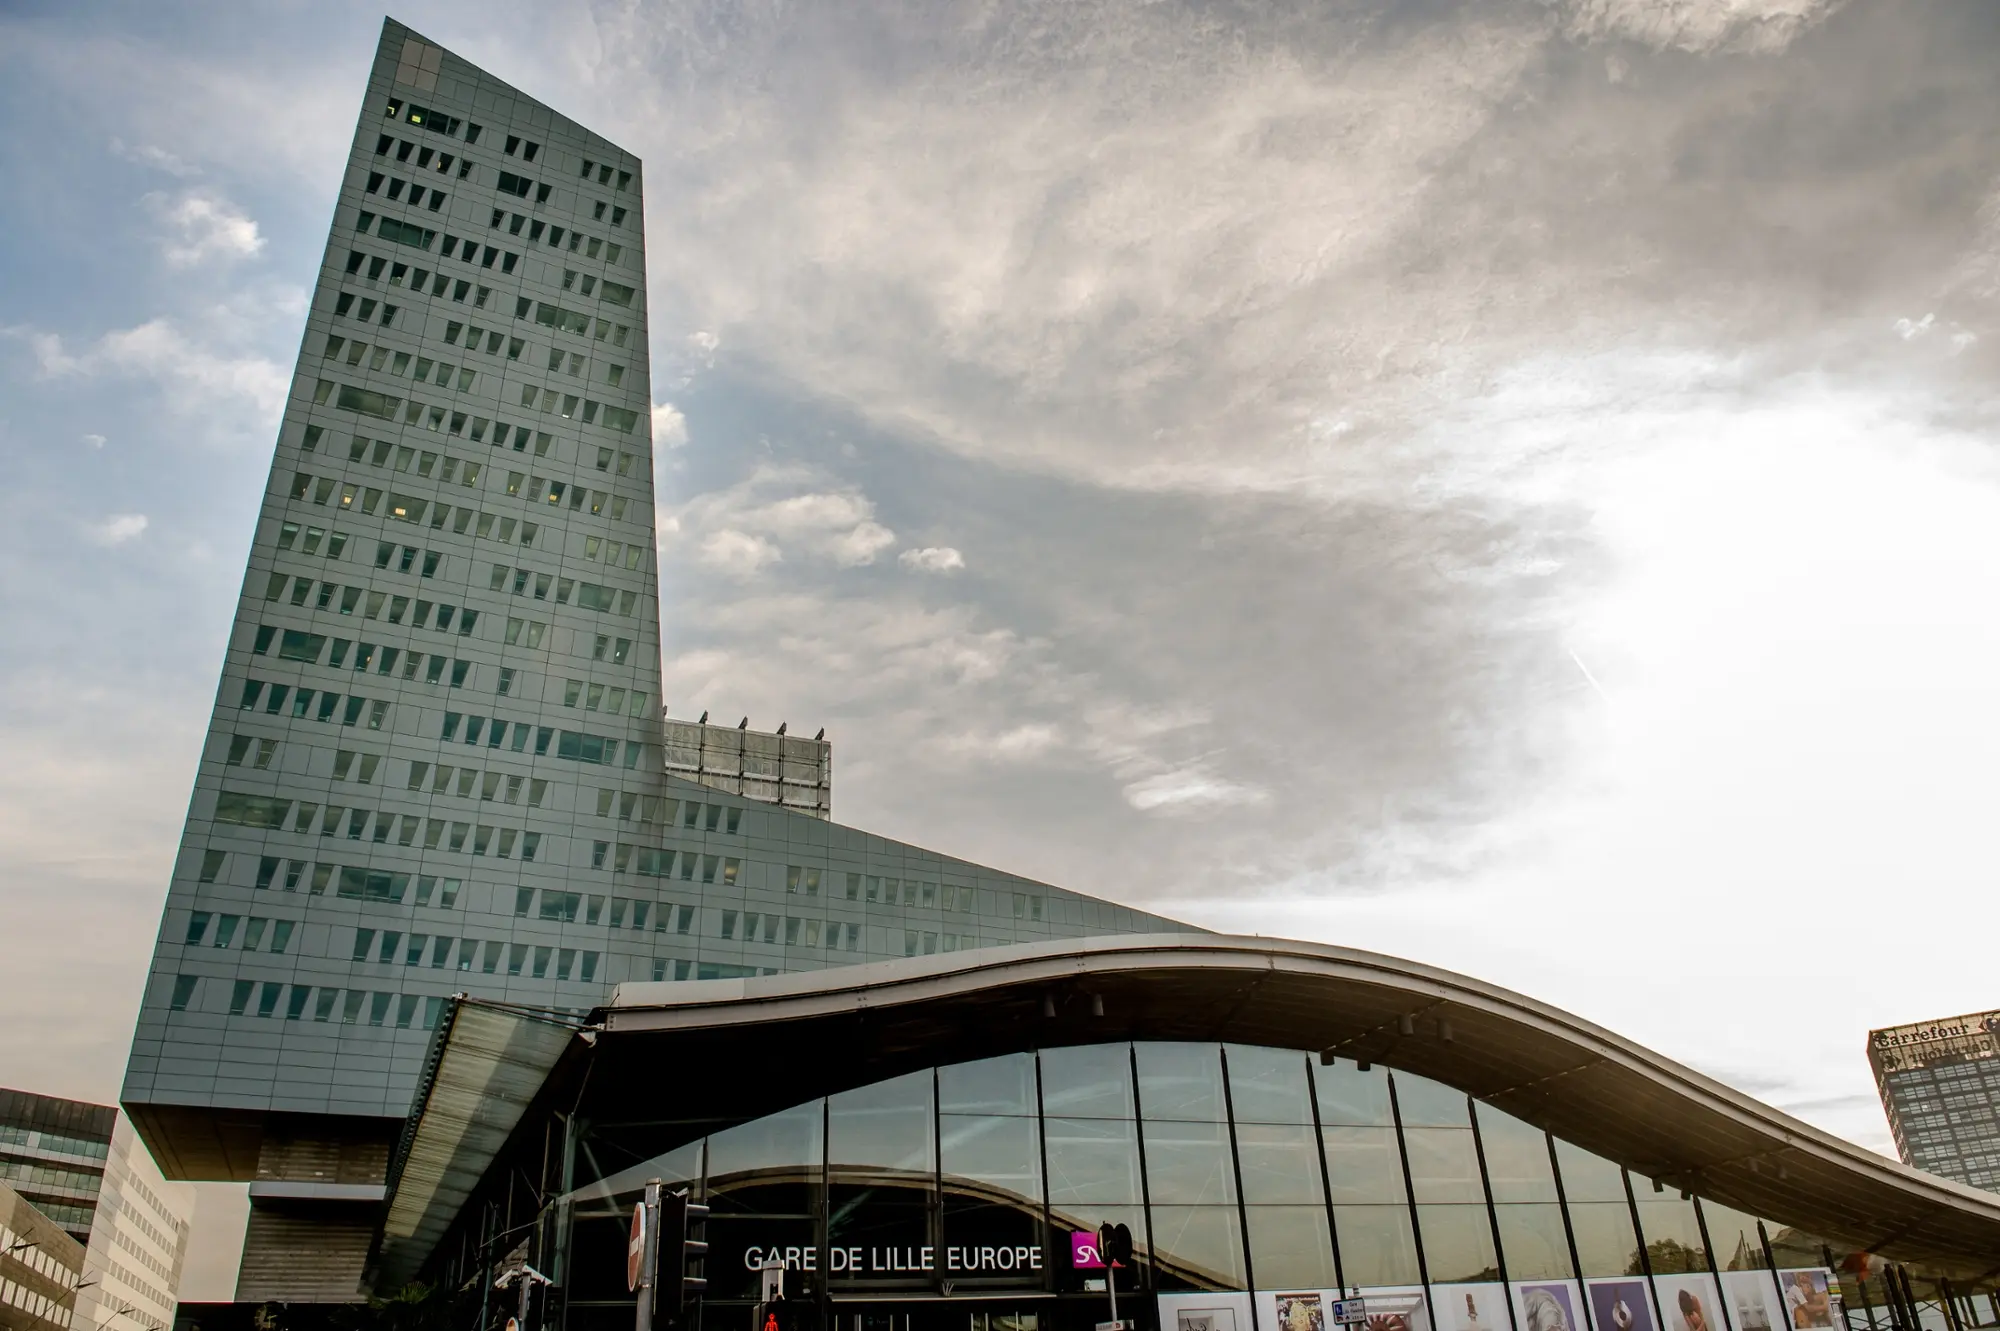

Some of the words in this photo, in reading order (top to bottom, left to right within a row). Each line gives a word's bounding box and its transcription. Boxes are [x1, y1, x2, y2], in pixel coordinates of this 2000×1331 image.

[744, 1246, 817, 1271] GARE
[830, 1247, 863, 1271] DE
[872, 1246, 935, 1271] LILLE
[947, 1246, 1043, 1270] EUROPE
